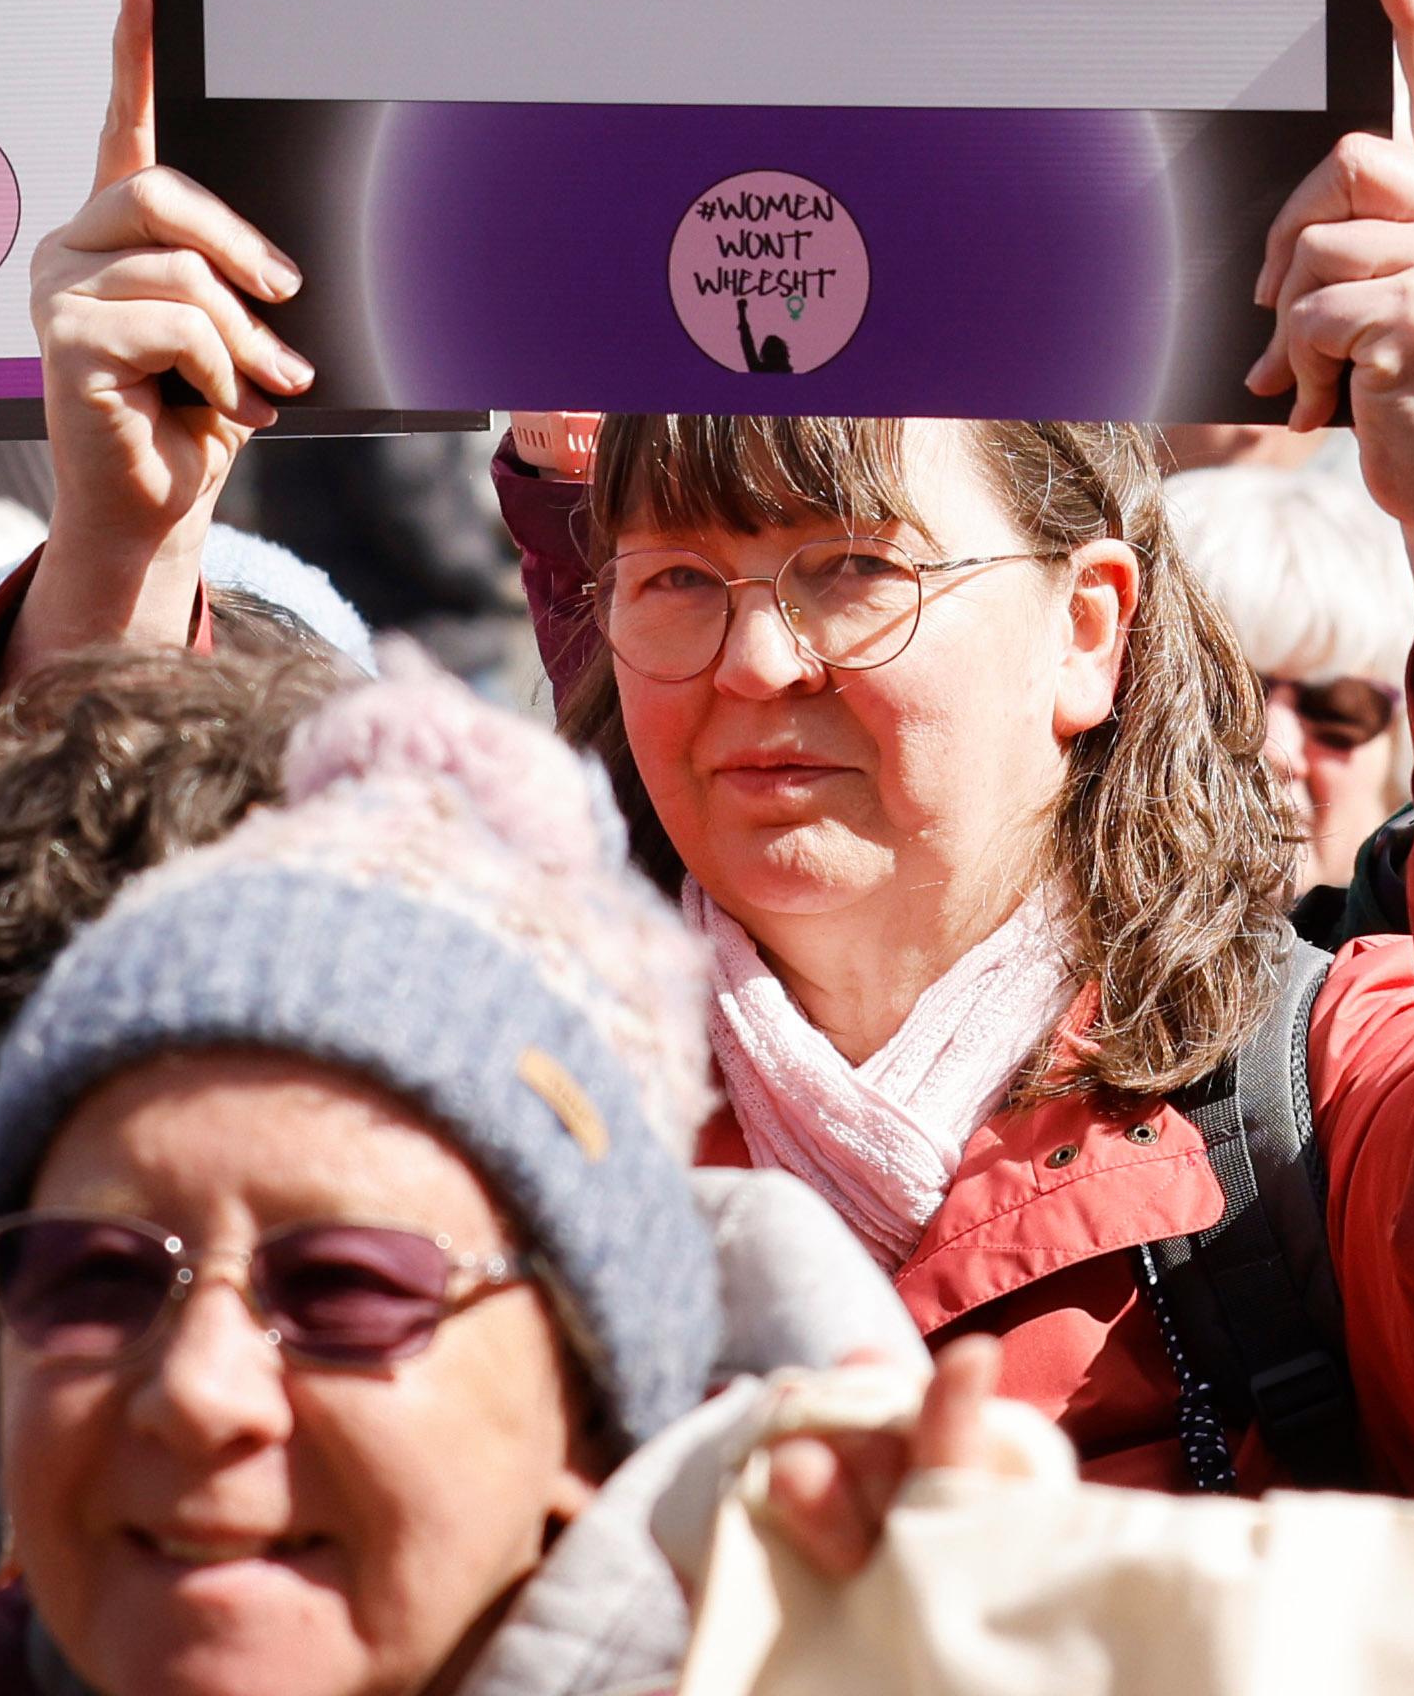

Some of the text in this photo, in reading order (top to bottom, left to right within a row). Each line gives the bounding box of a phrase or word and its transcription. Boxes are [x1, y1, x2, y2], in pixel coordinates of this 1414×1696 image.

[697, 191, 834, 222] #WOMEN
[716, 229, 813, 260] WONT
[693, 266, 836, 298] WHEESHT
